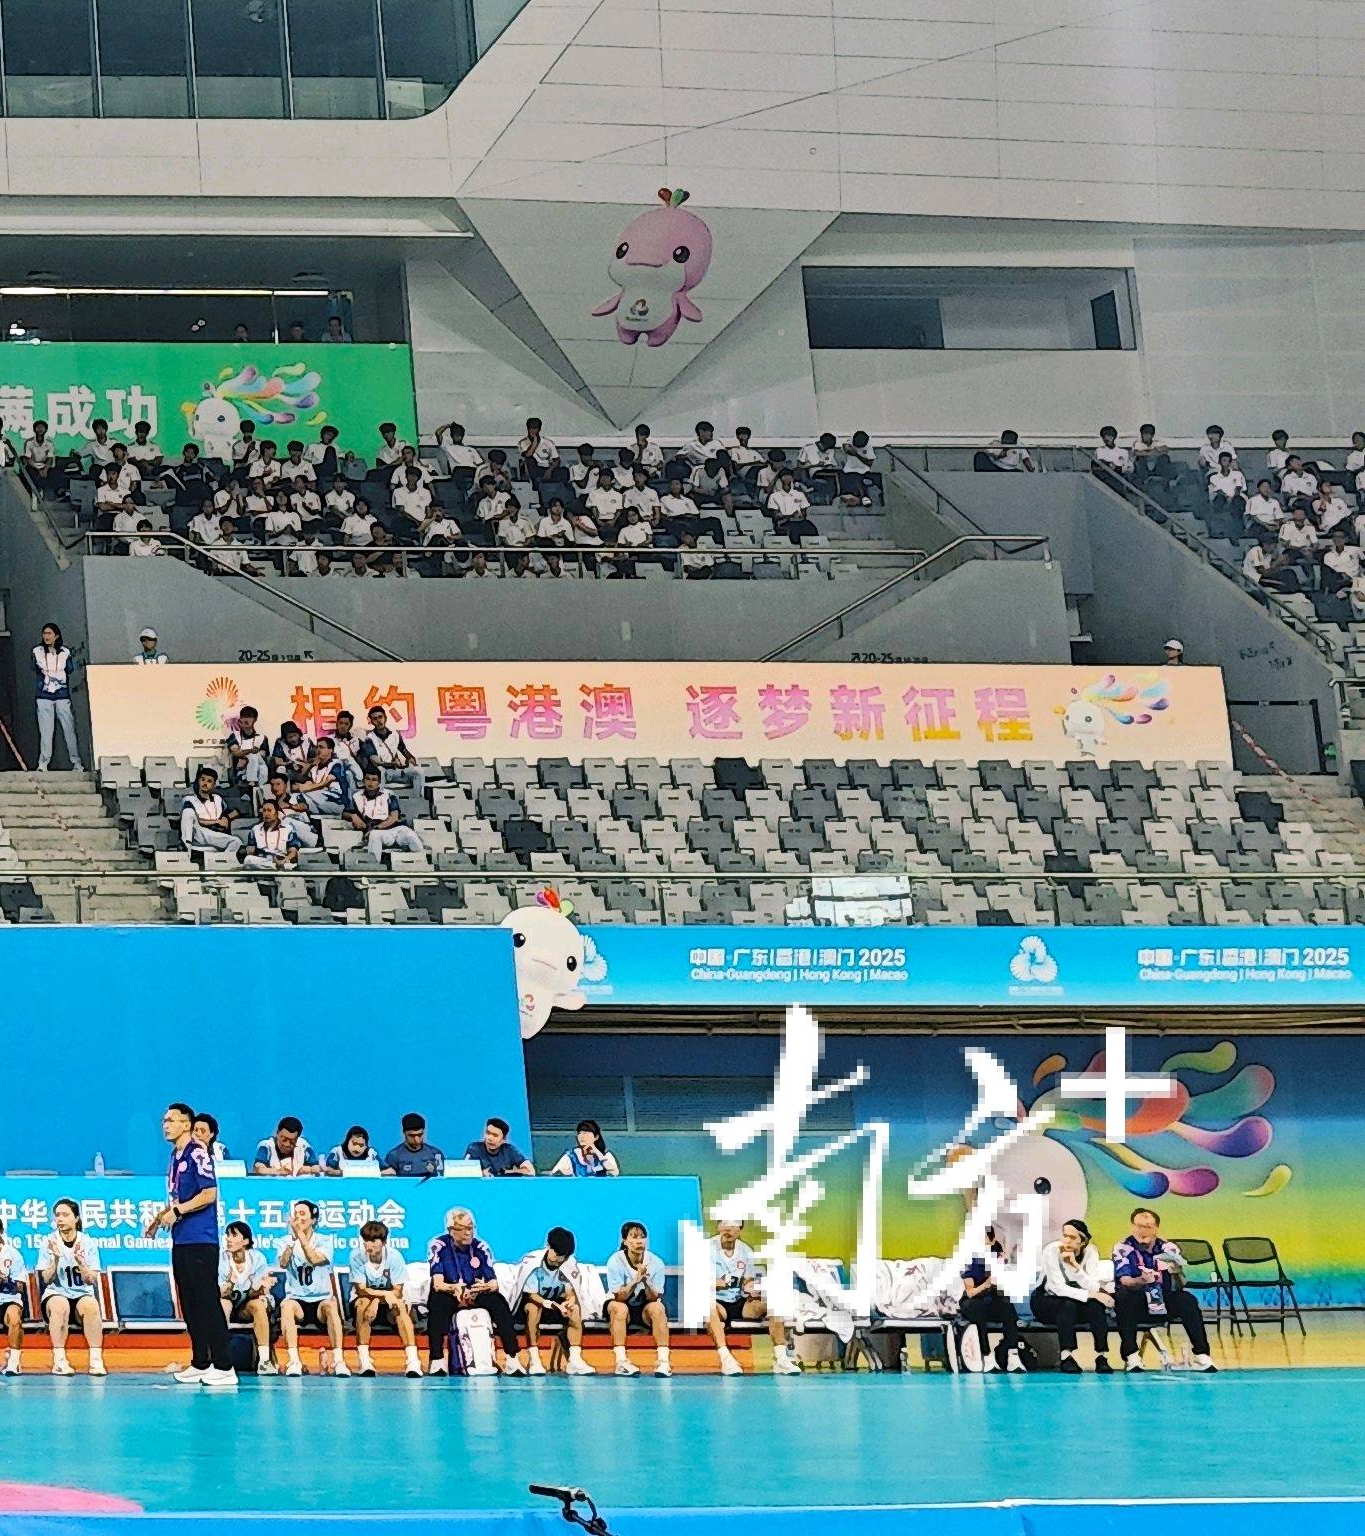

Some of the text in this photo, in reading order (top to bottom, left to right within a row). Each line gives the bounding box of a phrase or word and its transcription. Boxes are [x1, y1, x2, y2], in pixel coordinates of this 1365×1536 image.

[290, 681, 1036, 743] 相约粤港澳 逐梦新征程
[64, 1265, 84, 1287] 16
[296, 1265, 314, 1287] 18
